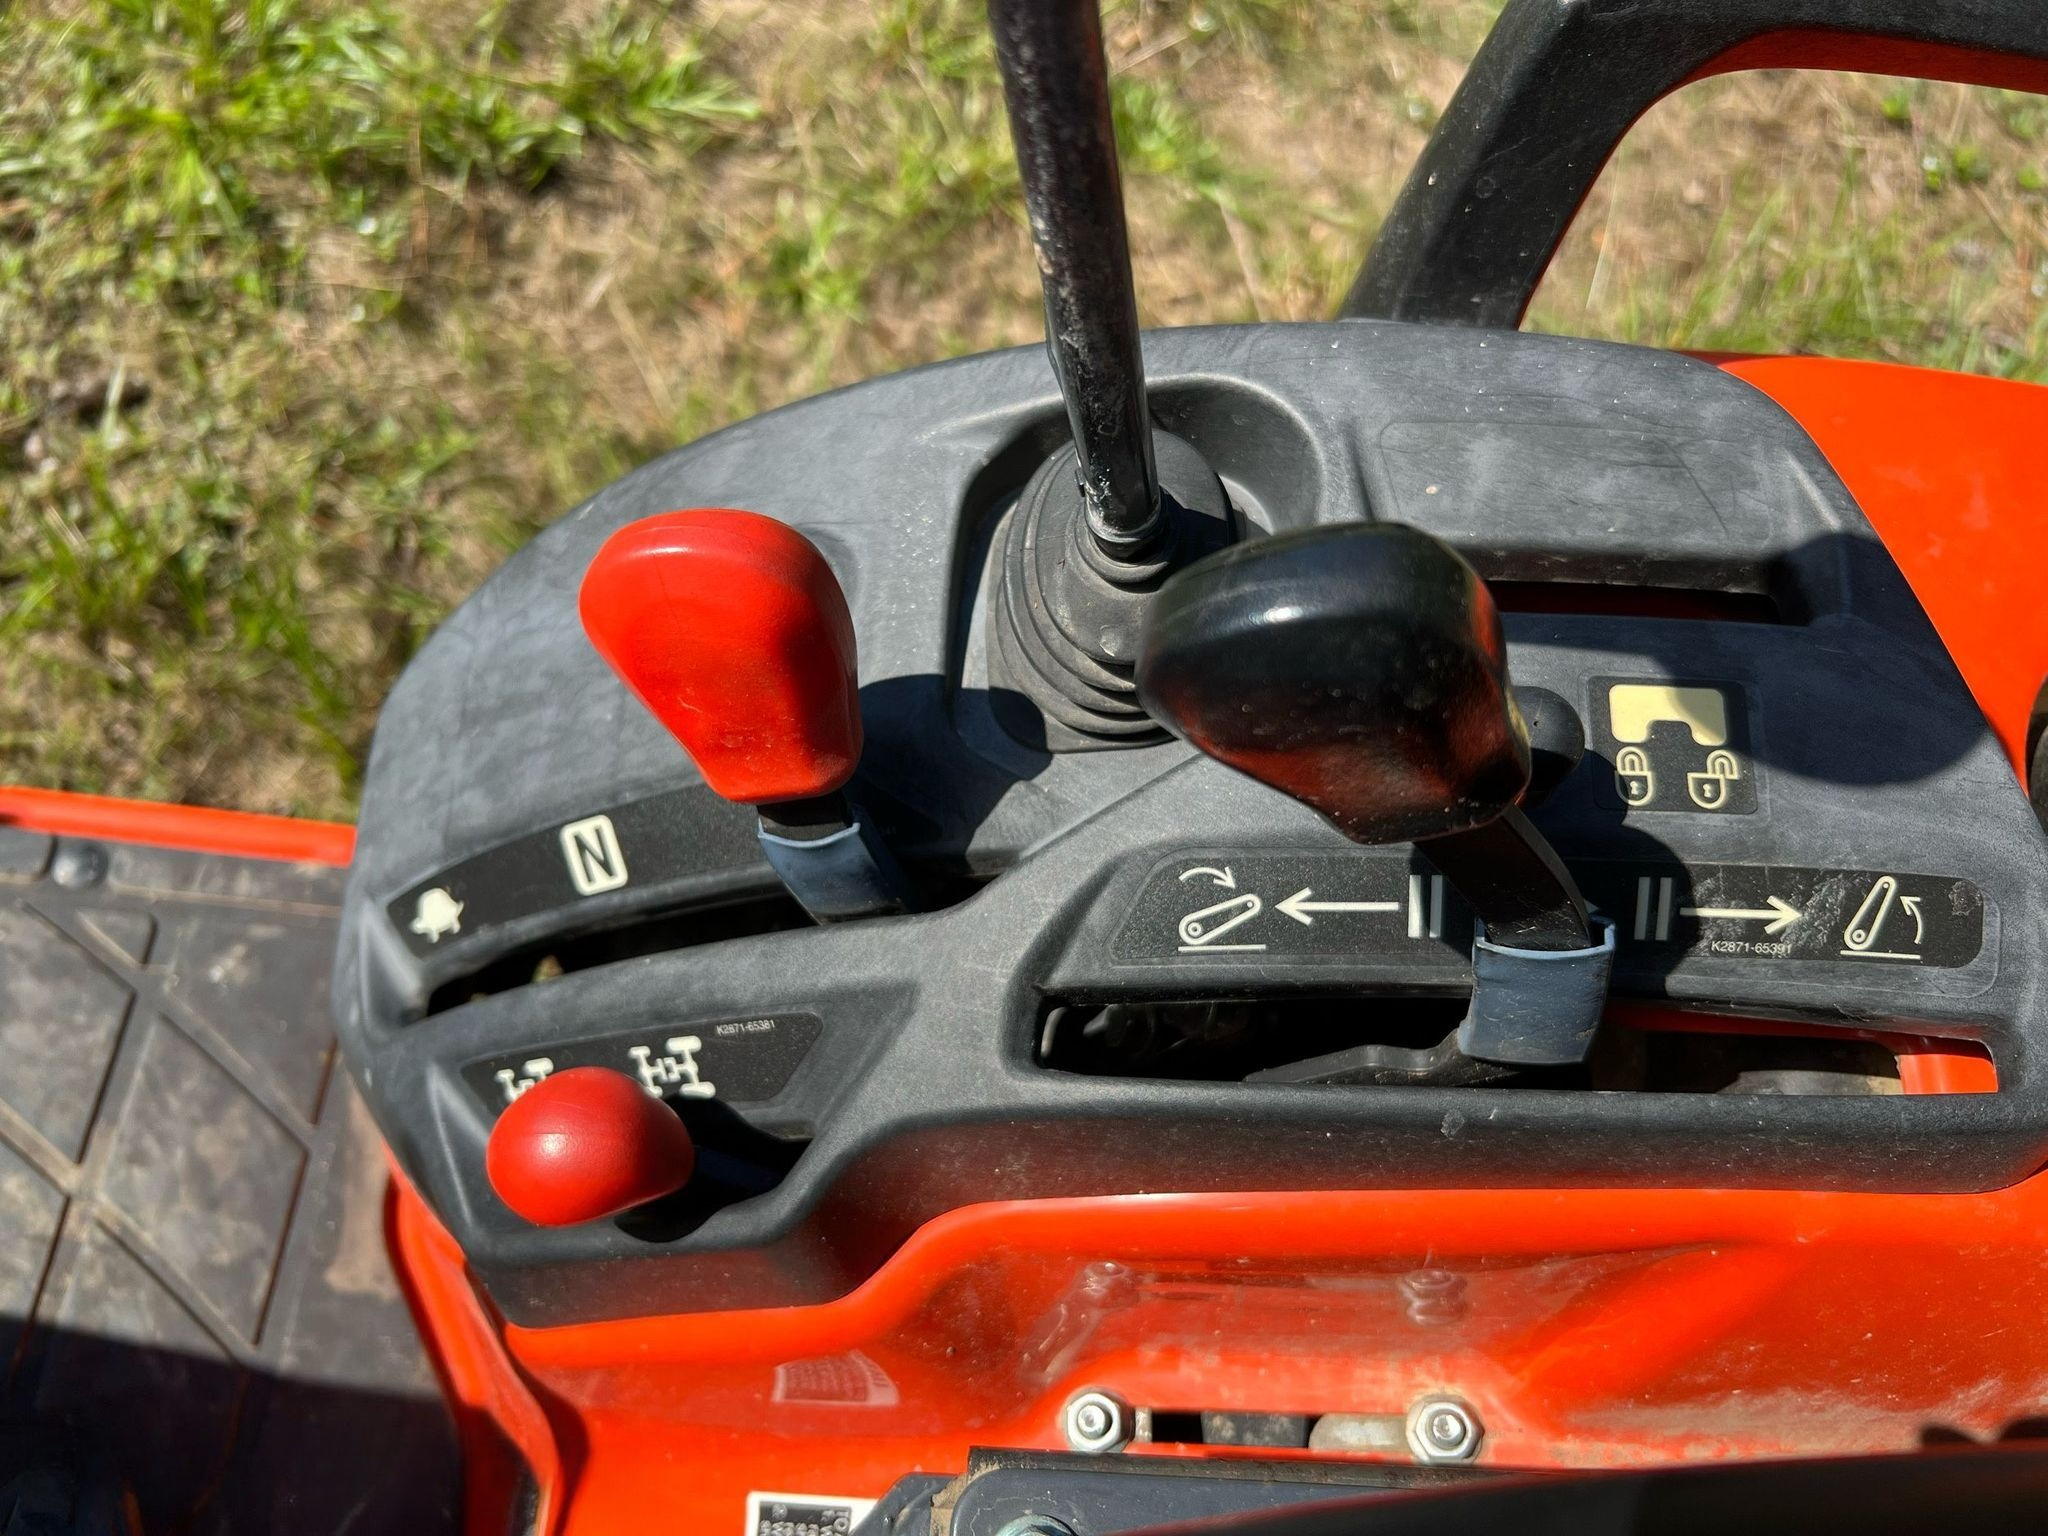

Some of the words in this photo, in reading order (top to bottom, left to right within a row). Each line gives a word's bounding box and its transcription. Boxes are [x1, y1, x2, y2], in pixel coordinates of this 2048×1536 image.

[570, 825, 617, 886] N
[1711, 940, 1793, 954] K2871-65391
[716, 1019, 776, 1036] K2871-65381
